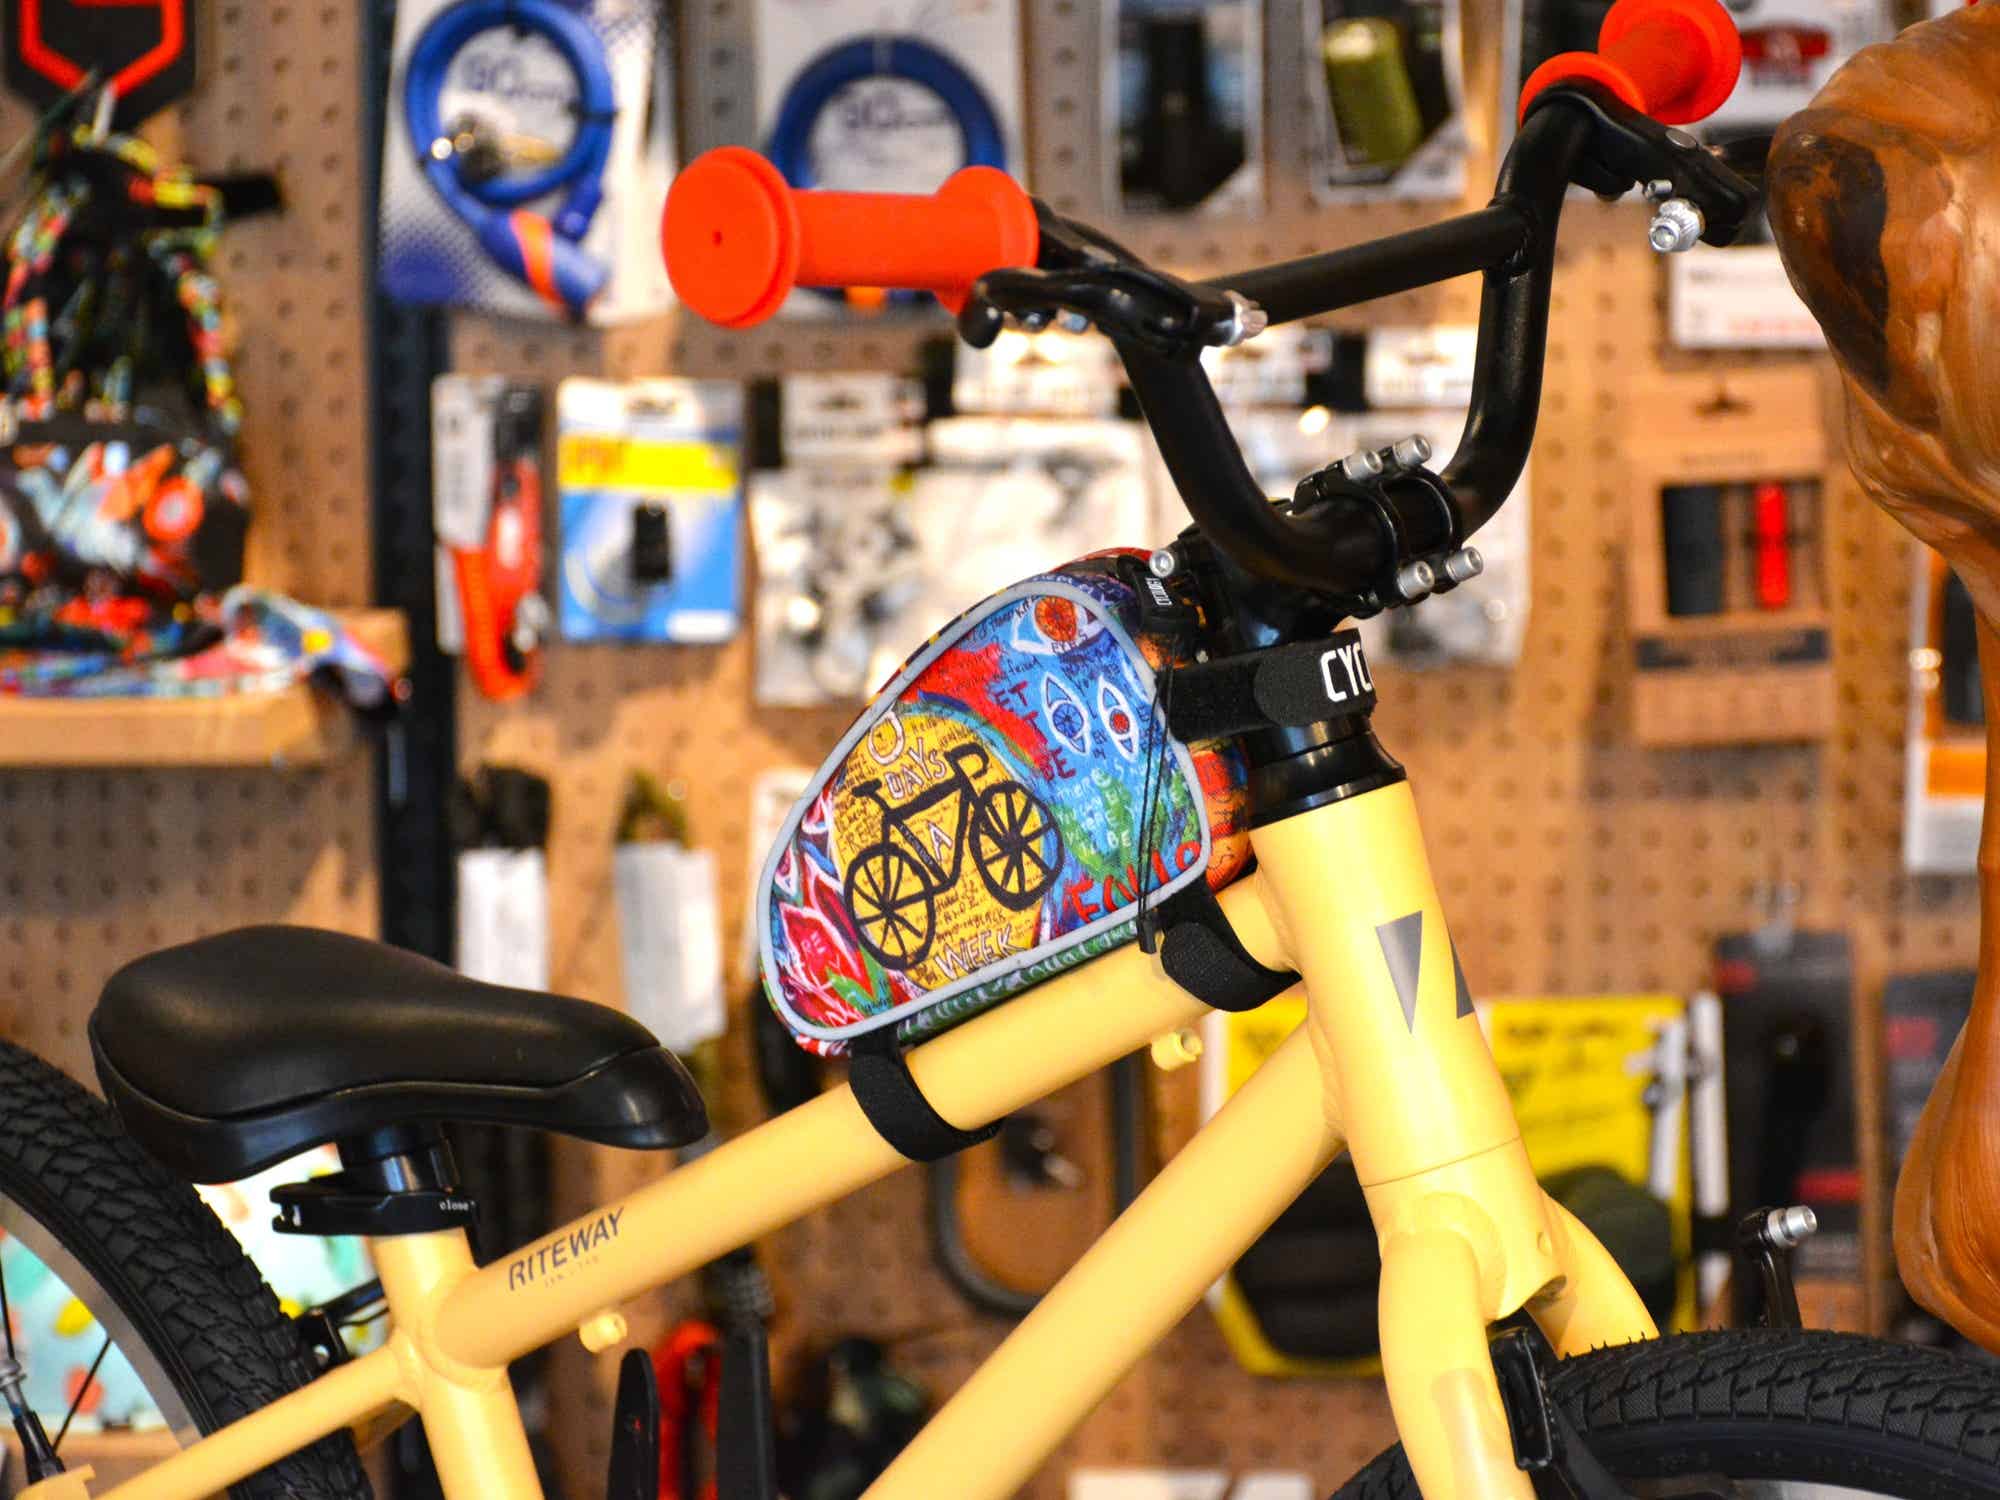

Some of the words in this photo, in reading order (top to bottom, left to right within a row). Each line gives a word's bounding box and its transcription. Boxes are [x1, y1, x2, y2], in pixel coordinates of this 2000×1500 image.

[1320, 641, 1373, 702] CYC
[884, 736, 947, 800] DAYS
[926, 821, 954, 863] A
[933, 923, 1027, 981] WEEK
[508, 1205, 625, 1292] RITEWAY
